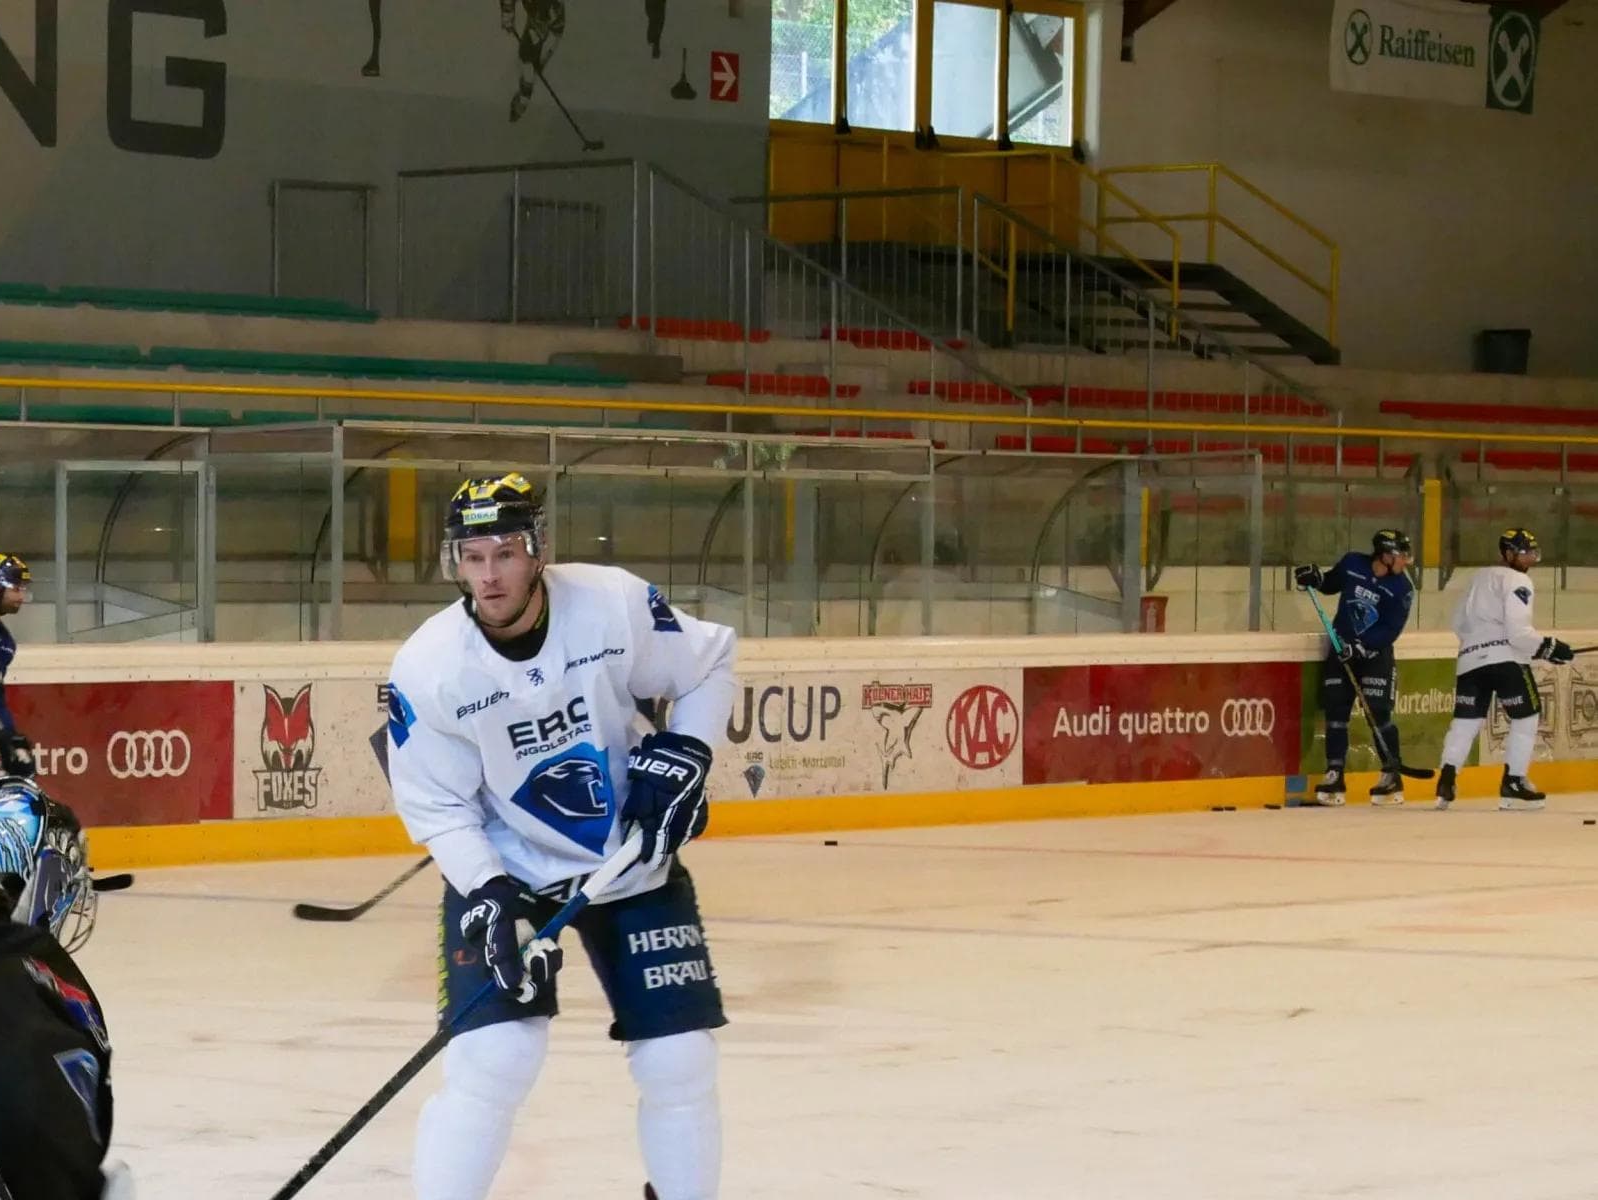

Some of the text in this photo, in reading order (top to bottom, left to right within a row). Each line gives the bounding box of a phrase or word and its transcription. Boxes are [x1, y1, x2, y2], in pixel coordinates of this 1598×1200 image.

[1378, 24, 1476, 68] Raiffeisen
[507, 695, 590, 749] ERC
[953, 686, 1012, 768] KAC
[1052, 705, 1210, 744] Audi quattro
[255, 770, 321, 812] FOXES
